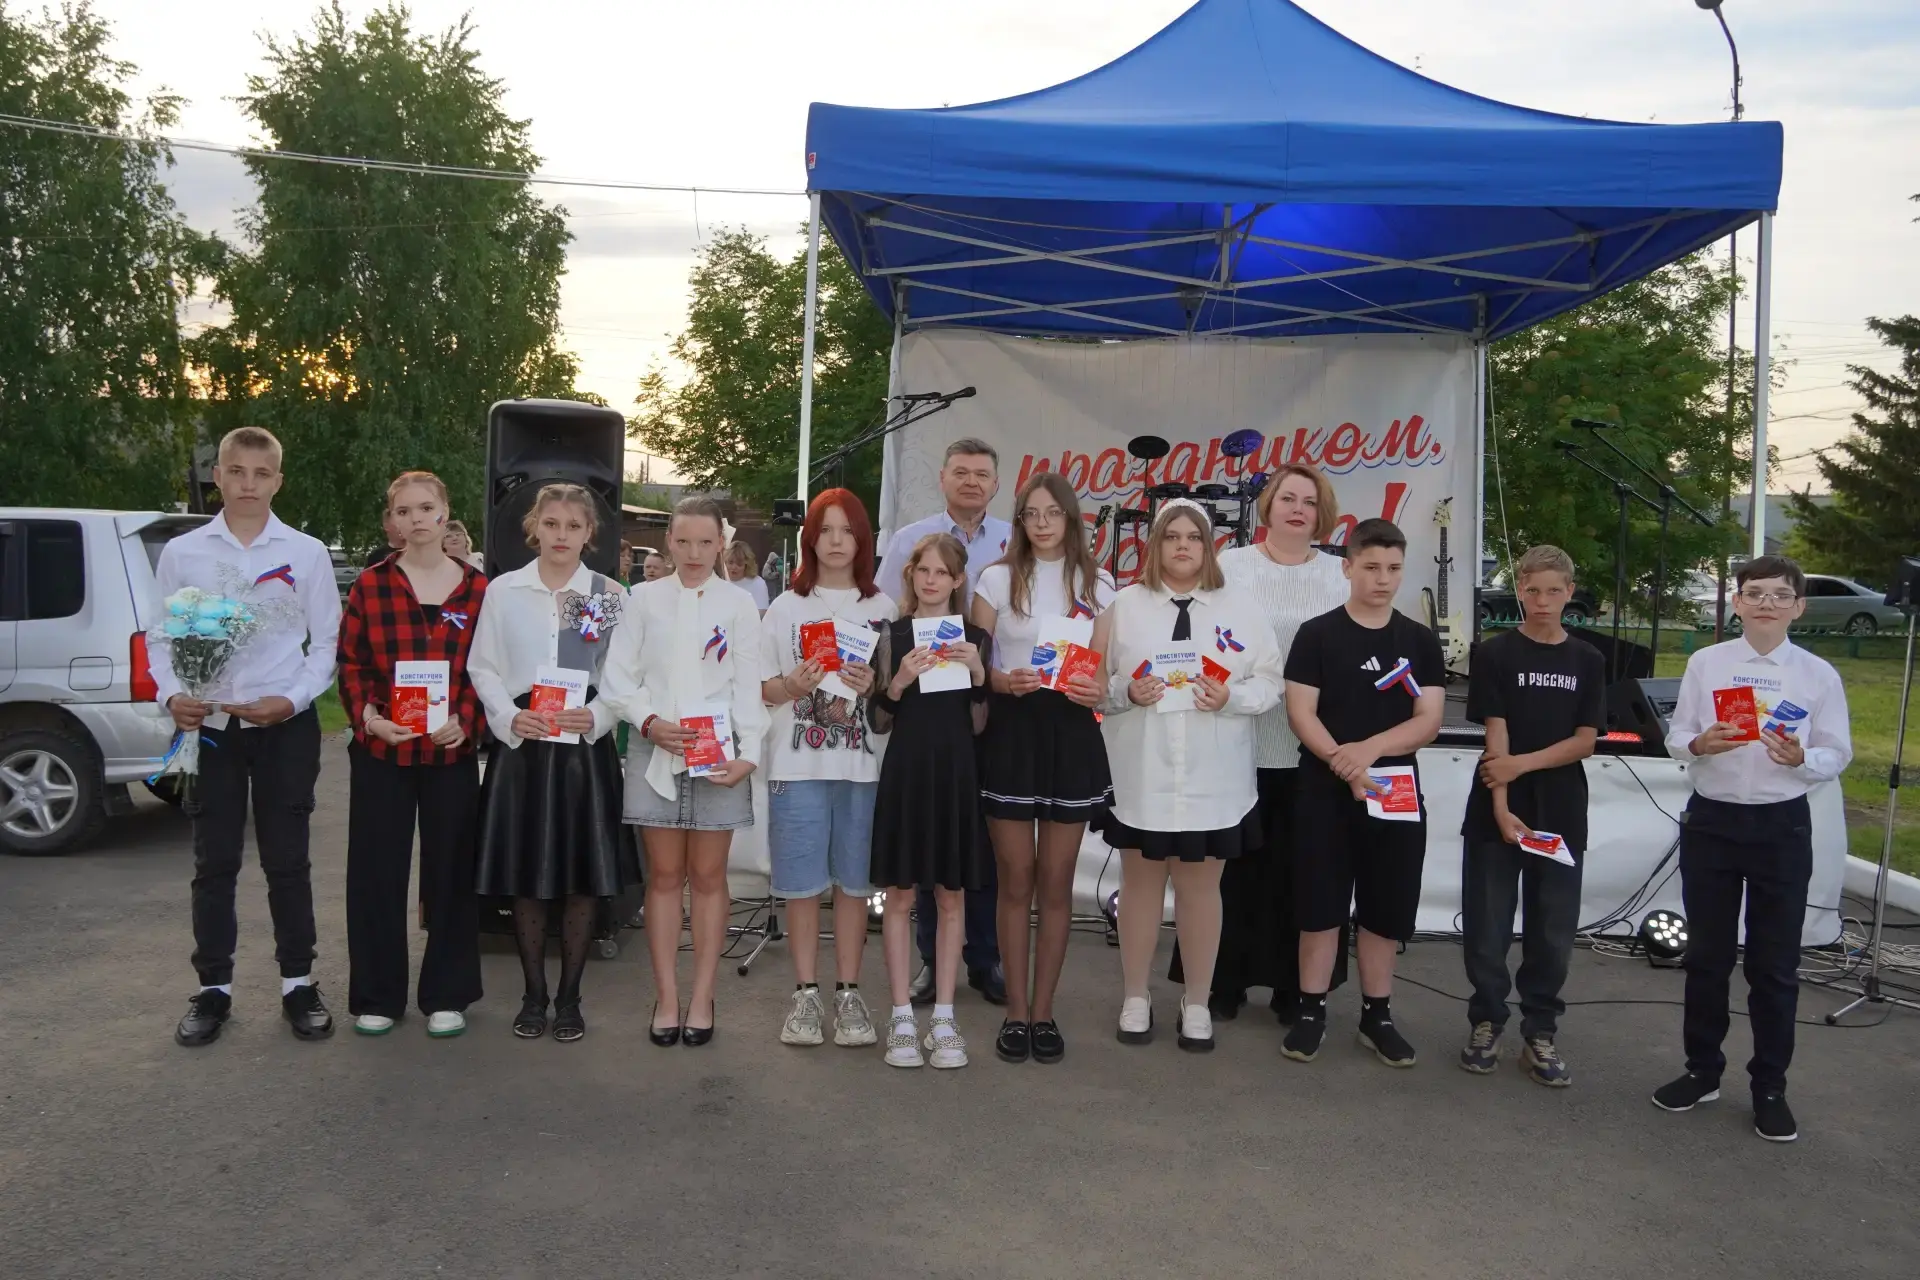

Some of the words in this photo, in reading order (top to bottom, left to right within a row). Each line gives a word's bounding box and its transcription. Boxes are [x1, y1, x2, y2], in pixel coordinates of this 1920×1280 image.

[835, 631, 871, 648] ОНСТИТУЦИЯ
[1156, 652, 1196, 660] КОНСТИТУЦИЯ
[541, 678, 582, 689] КОНСТИТУЦИЯ
[1518, 673, 1525, 686] Я
[1529, 672, 1577, 691] РУССКИЙ
[1733, 675, 1782, 687] КОНСТИТУЦИЯ
